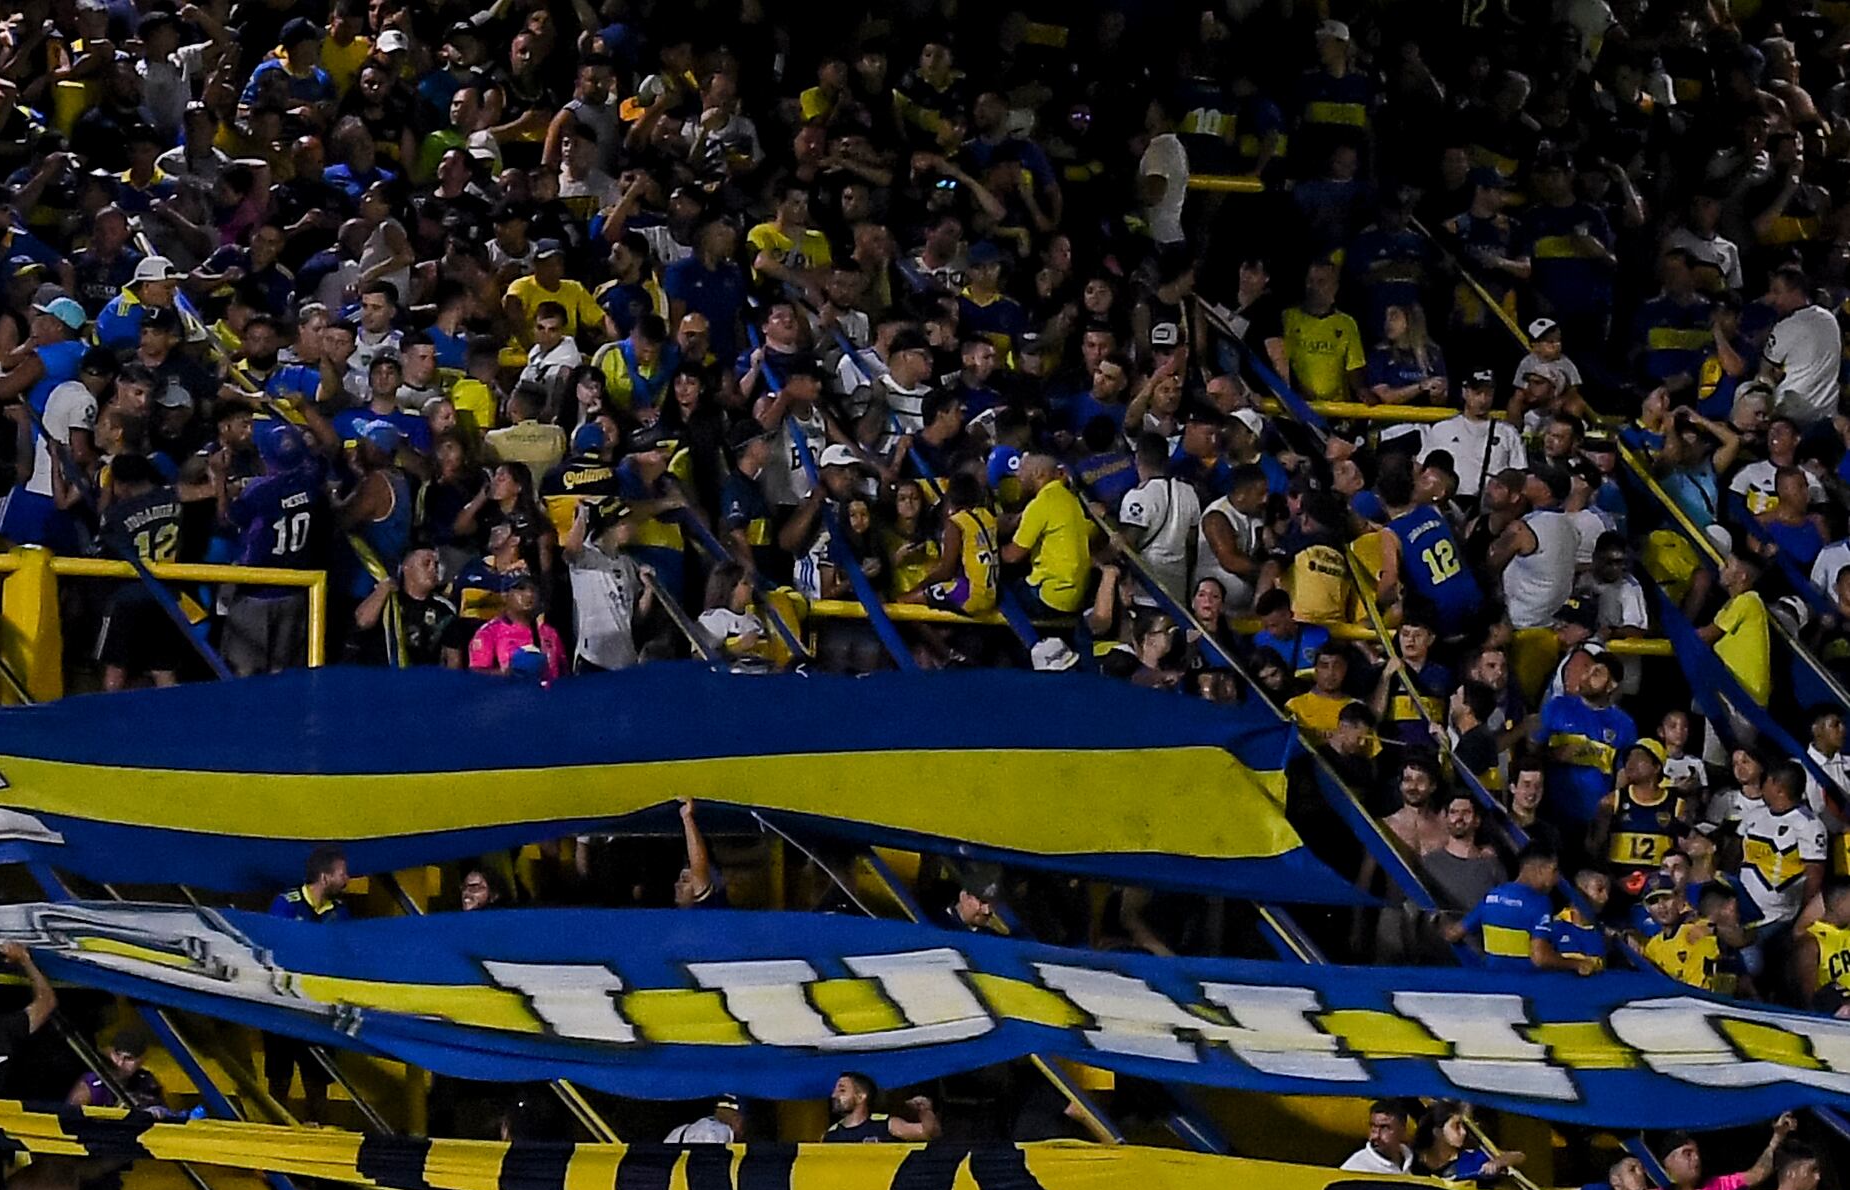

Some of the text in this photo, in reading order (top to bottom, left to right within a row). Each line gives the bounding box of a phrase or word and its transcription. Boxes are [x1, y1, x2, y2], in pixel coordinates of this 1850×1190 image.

[133, 522, 179, 564] 12
[272, 512, 311, 555] 10
[1422, 538, 1461, 585] 12
[1633, 837, 1655, 861] 12
